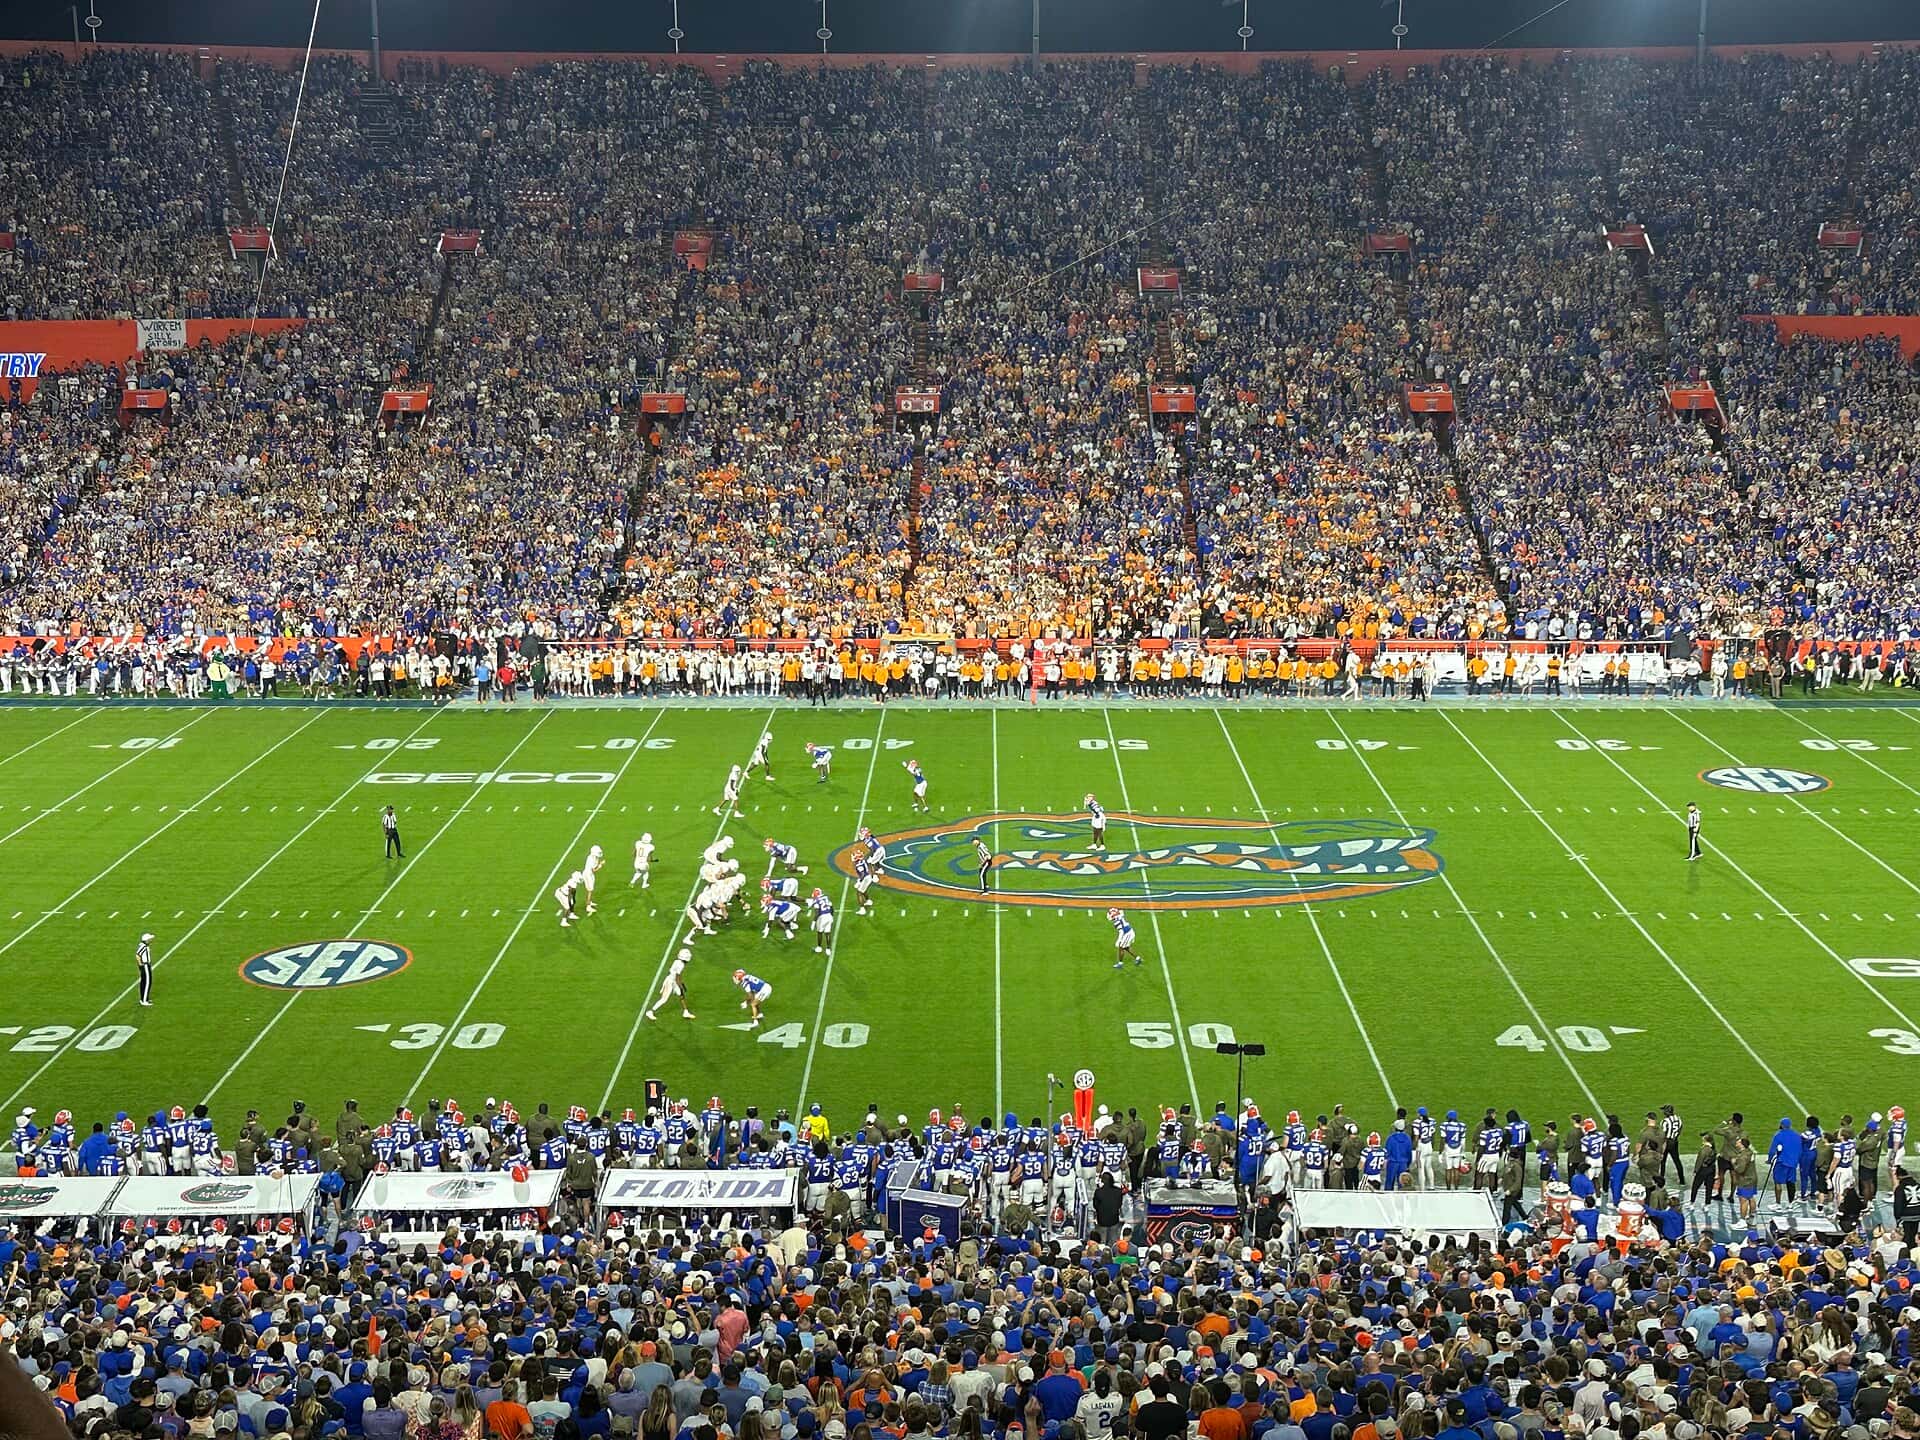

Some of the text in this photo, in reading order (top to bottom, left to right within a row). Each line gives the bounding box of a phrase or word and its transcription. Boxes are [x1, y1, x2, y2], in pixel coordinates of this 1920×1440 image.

[363, 772, 616, 784] GEICO
[1706, 768, 1823, 793] SEC
[252, 942, 398, 986] SEC
[9, 1025, 138, 1052] 20
[390, 1023, 506, 1050] 30
[757, 1022, 870, 1049] 40
[1126, 1022, 1246, 1049] 50
[1494, 1024, 1612, 1052] 40
[649, 1082, 656, 1099] 1
[171, 1128, 187, 1143] 14
[619, 1131, 633, 1146] 91
[667, 1125, 684, 1141] 22
[1518, 1128, 1528, 1145] 11
[589, 1135, 606, 1150] 86
[638, 1135, 656, 1151] 53
[377, 1148, 393, 1162] 17
[422, 1149, 434, 1163] 2
[550, 1143, 567, 1163] 57
[1083, 1150, 1099, 1163] 42
[1105, 1152, 1121, 1166] 55
[1306, 1151, 1323, 1166] 83
[47, 1155, 56, 1169] 9
[994, 1154, 1010, 1168] 33
[1024, 1161, 1042, 1176] 59
[813, 1164, 831, 1177] 75
[1098, 1411, 1111, 1429] 2
